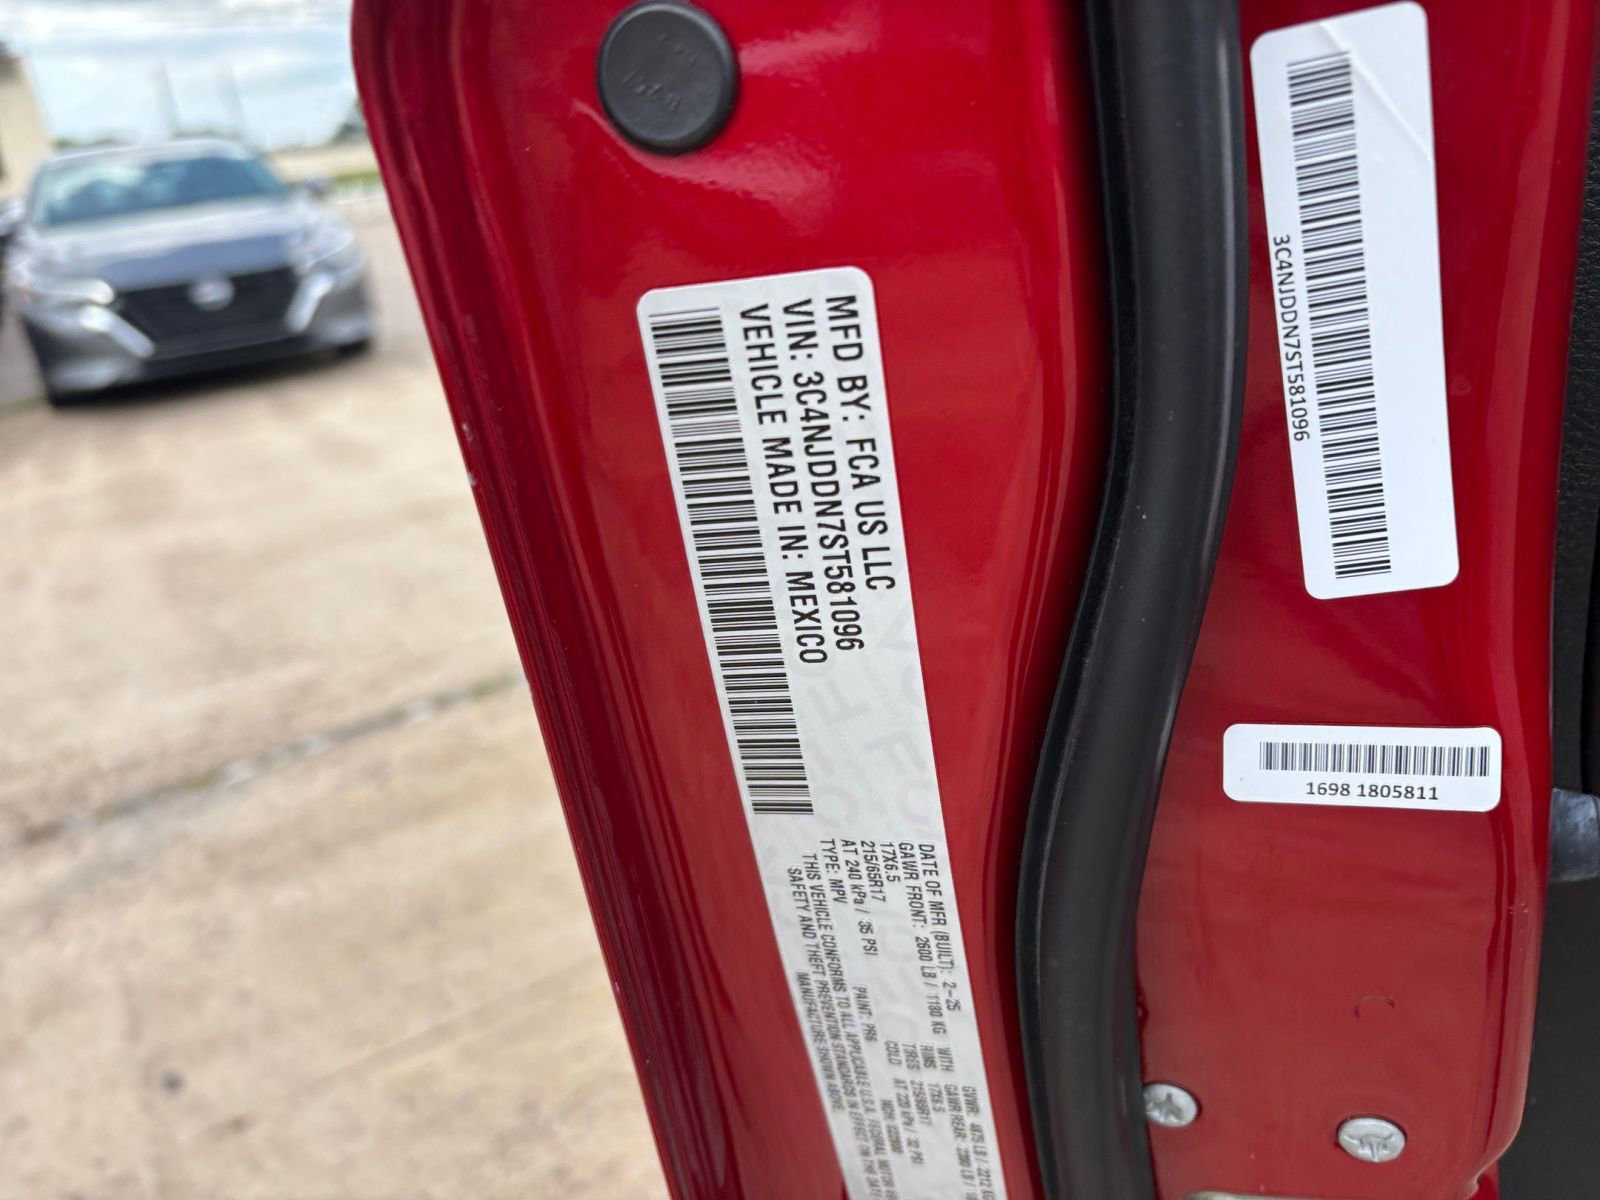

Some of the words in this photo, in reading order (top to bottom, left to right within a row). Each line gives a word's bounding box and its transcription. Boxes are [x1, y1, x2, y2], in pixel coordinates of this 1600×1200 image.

[780, 298, 818, 361] VIN:
[824, 294, 863, 363] MFD
[1273, 234, 1311, 442] 3C4NJDDN7ST581096
[739, 303, 785, 424] VEHICLE
[836, 373, 872, 422] BY:
[762, 435, 801, 514] MADE
[846, 436, 882, 488] FCA
[792, 370, 865, 650] 3C4NJDDN7ST581096
[856, 499, 889, 535] US
[779, 524, 809, 559] IN:
[864, 546, 897, 590] LLC
[787, 569, 827, 665] MEXICO
[1306, 781, 1351, 797] 1698
[1356, 782, 1439, 801] 1805811
[820, 840, 841, 873] TYPE:
[840, 839, 857, 855] AT
[880, 842, 900, 881] 17X6.5
[897, 842, 918, 879] GAWR
[919, 844, 938, 876] DATE
[801, 854, 821, 879] THIS
[845, 860, 863, 879] 240
[860, 840, 886, 902] 215/65R17
[788, 868, 810, 912] SAFETY
[829, 878, 847, 903] MPV
[850, 884, 868, 903] kPa
[925, 880, 941, 896] OF
[809, 885, 833, 930] VEHICLE
[905, 885, 927, 927] FRONT:
[929, 900, 946, 925] MFR
[800, 915, 817, 938] AND
[859, 920, 874, 933] 35
[807, 943, 826, 975] THEFT
[821, 934, 847, 991] CONFORMS
[862, 937, 879, 955] PSI
[915, 935, 934, 961] 2600
[931, 931, 955, 973] (BUILT):
[921, 965, 937, 978] LB
[796, 971, 826, 1043] MANUFACTURE
[816, 979, 842, 1039] PREVENTION
[836, 996, 851, 1007] TO
[853, 986, 873, 1018] PAINT:
[840, 1011, 856, 1027] ALL
[932, 1020, 947, 1033] KG
[845, 1031, 870, 1087] APPLICABLE
[885, 1040, 902, 1064] COLD
[903, 1043, 920, 1070] TIRES
[920, 1044, 937, 1069] RIMS
[937, 1047, 954, 1071] WITH
[832, 1042, 856, 1097] STANDARDS
